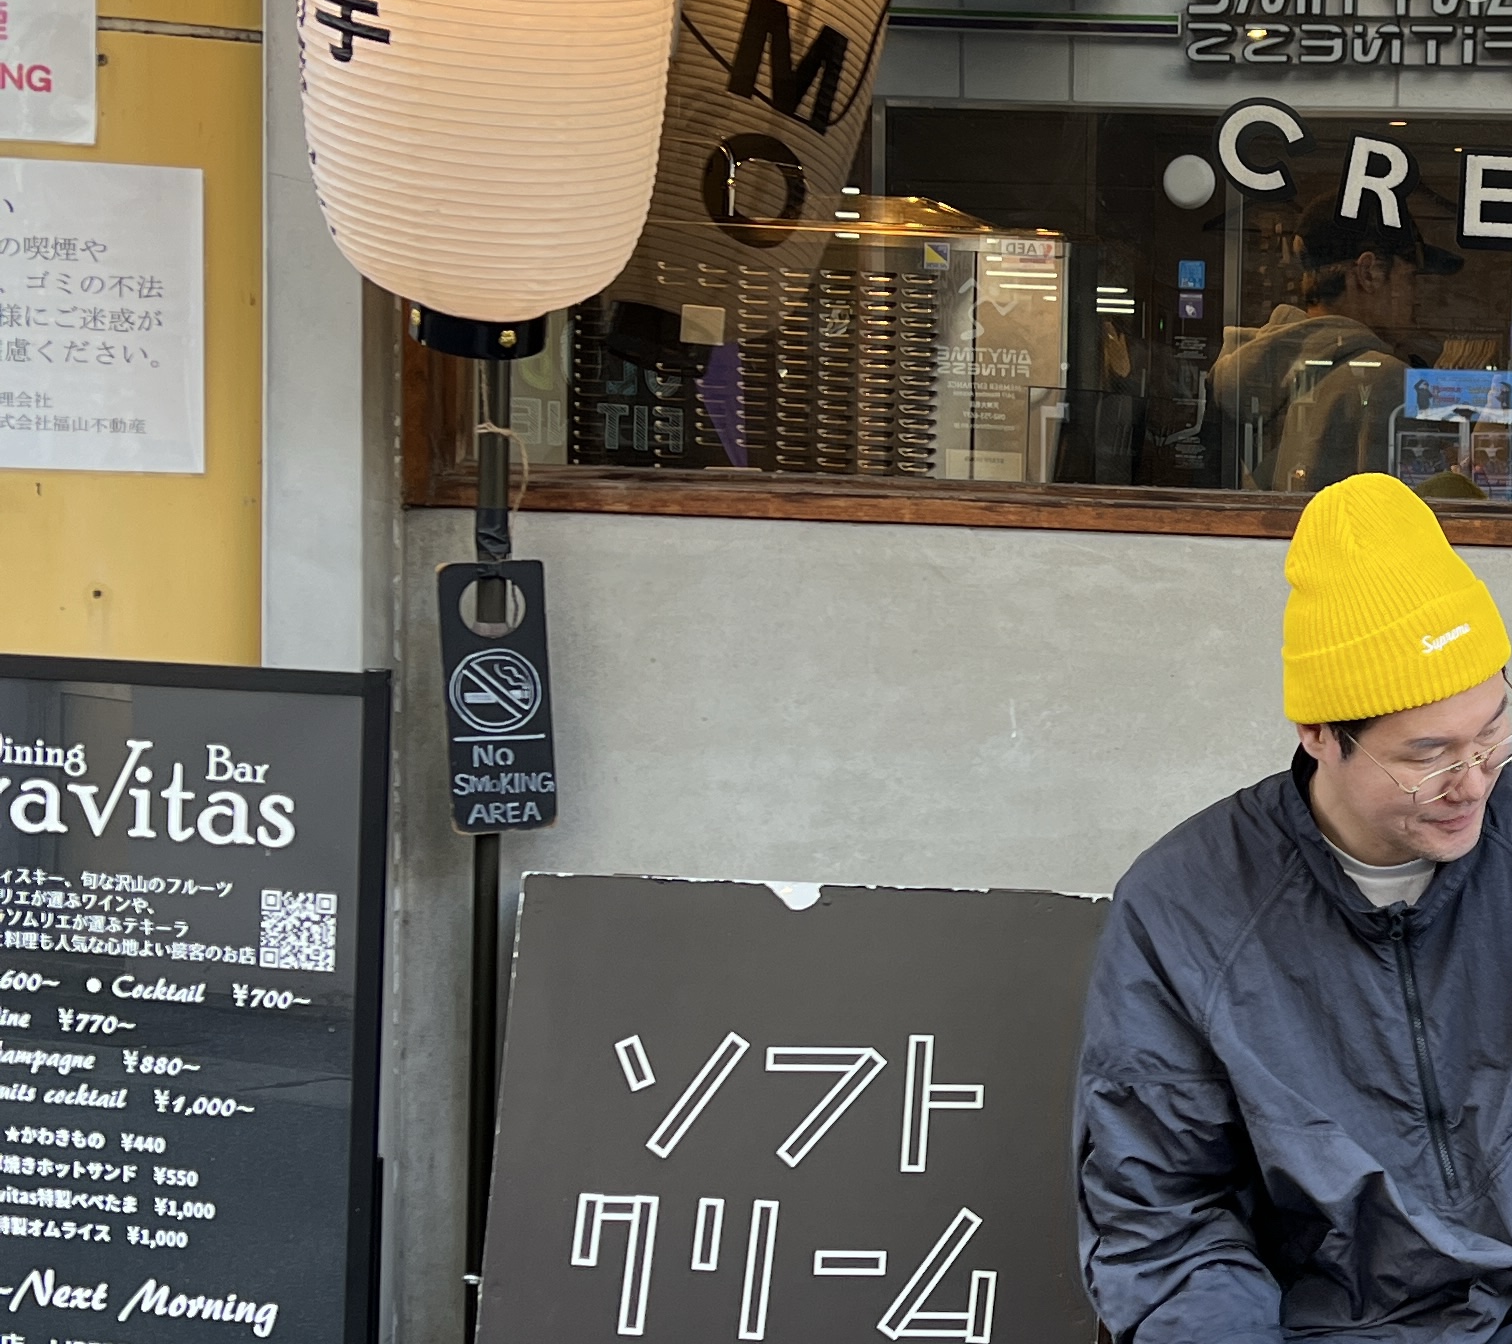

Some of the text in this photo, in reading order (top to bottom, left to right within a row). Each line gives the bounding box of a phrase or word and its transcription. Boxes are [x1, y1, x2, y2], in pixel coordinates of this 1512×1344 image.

[0, 337, 160, 369] 慮ください。
[0, 732, 271, 785] ining Bar
[472, 745, 515, 767] NO
[0, 739, 296, 848] avitas
[467, 802, 542, 825] AREA
[0, 930, 257, 965] 料理も人気な心地よい接客のお店
[111, 972, 207, 1003] Cocktail
[0, 1006, 31, 1029] ine
[43, 1083, 128, 1108] cocktail
[614, 1031, 985, 1173] ソフト
[120, 1131, 167, 1154] ¥440
[0, 1153, 199, 1188] 焼きホットサンド ¥550
[154, 1197, 216, 1221] ¥1,000
[126, 1225, 189, 1249] ¥1,000
[570, 1192, 997, 1344] クリーム
[117, 1278, 279, 1338] Morning
